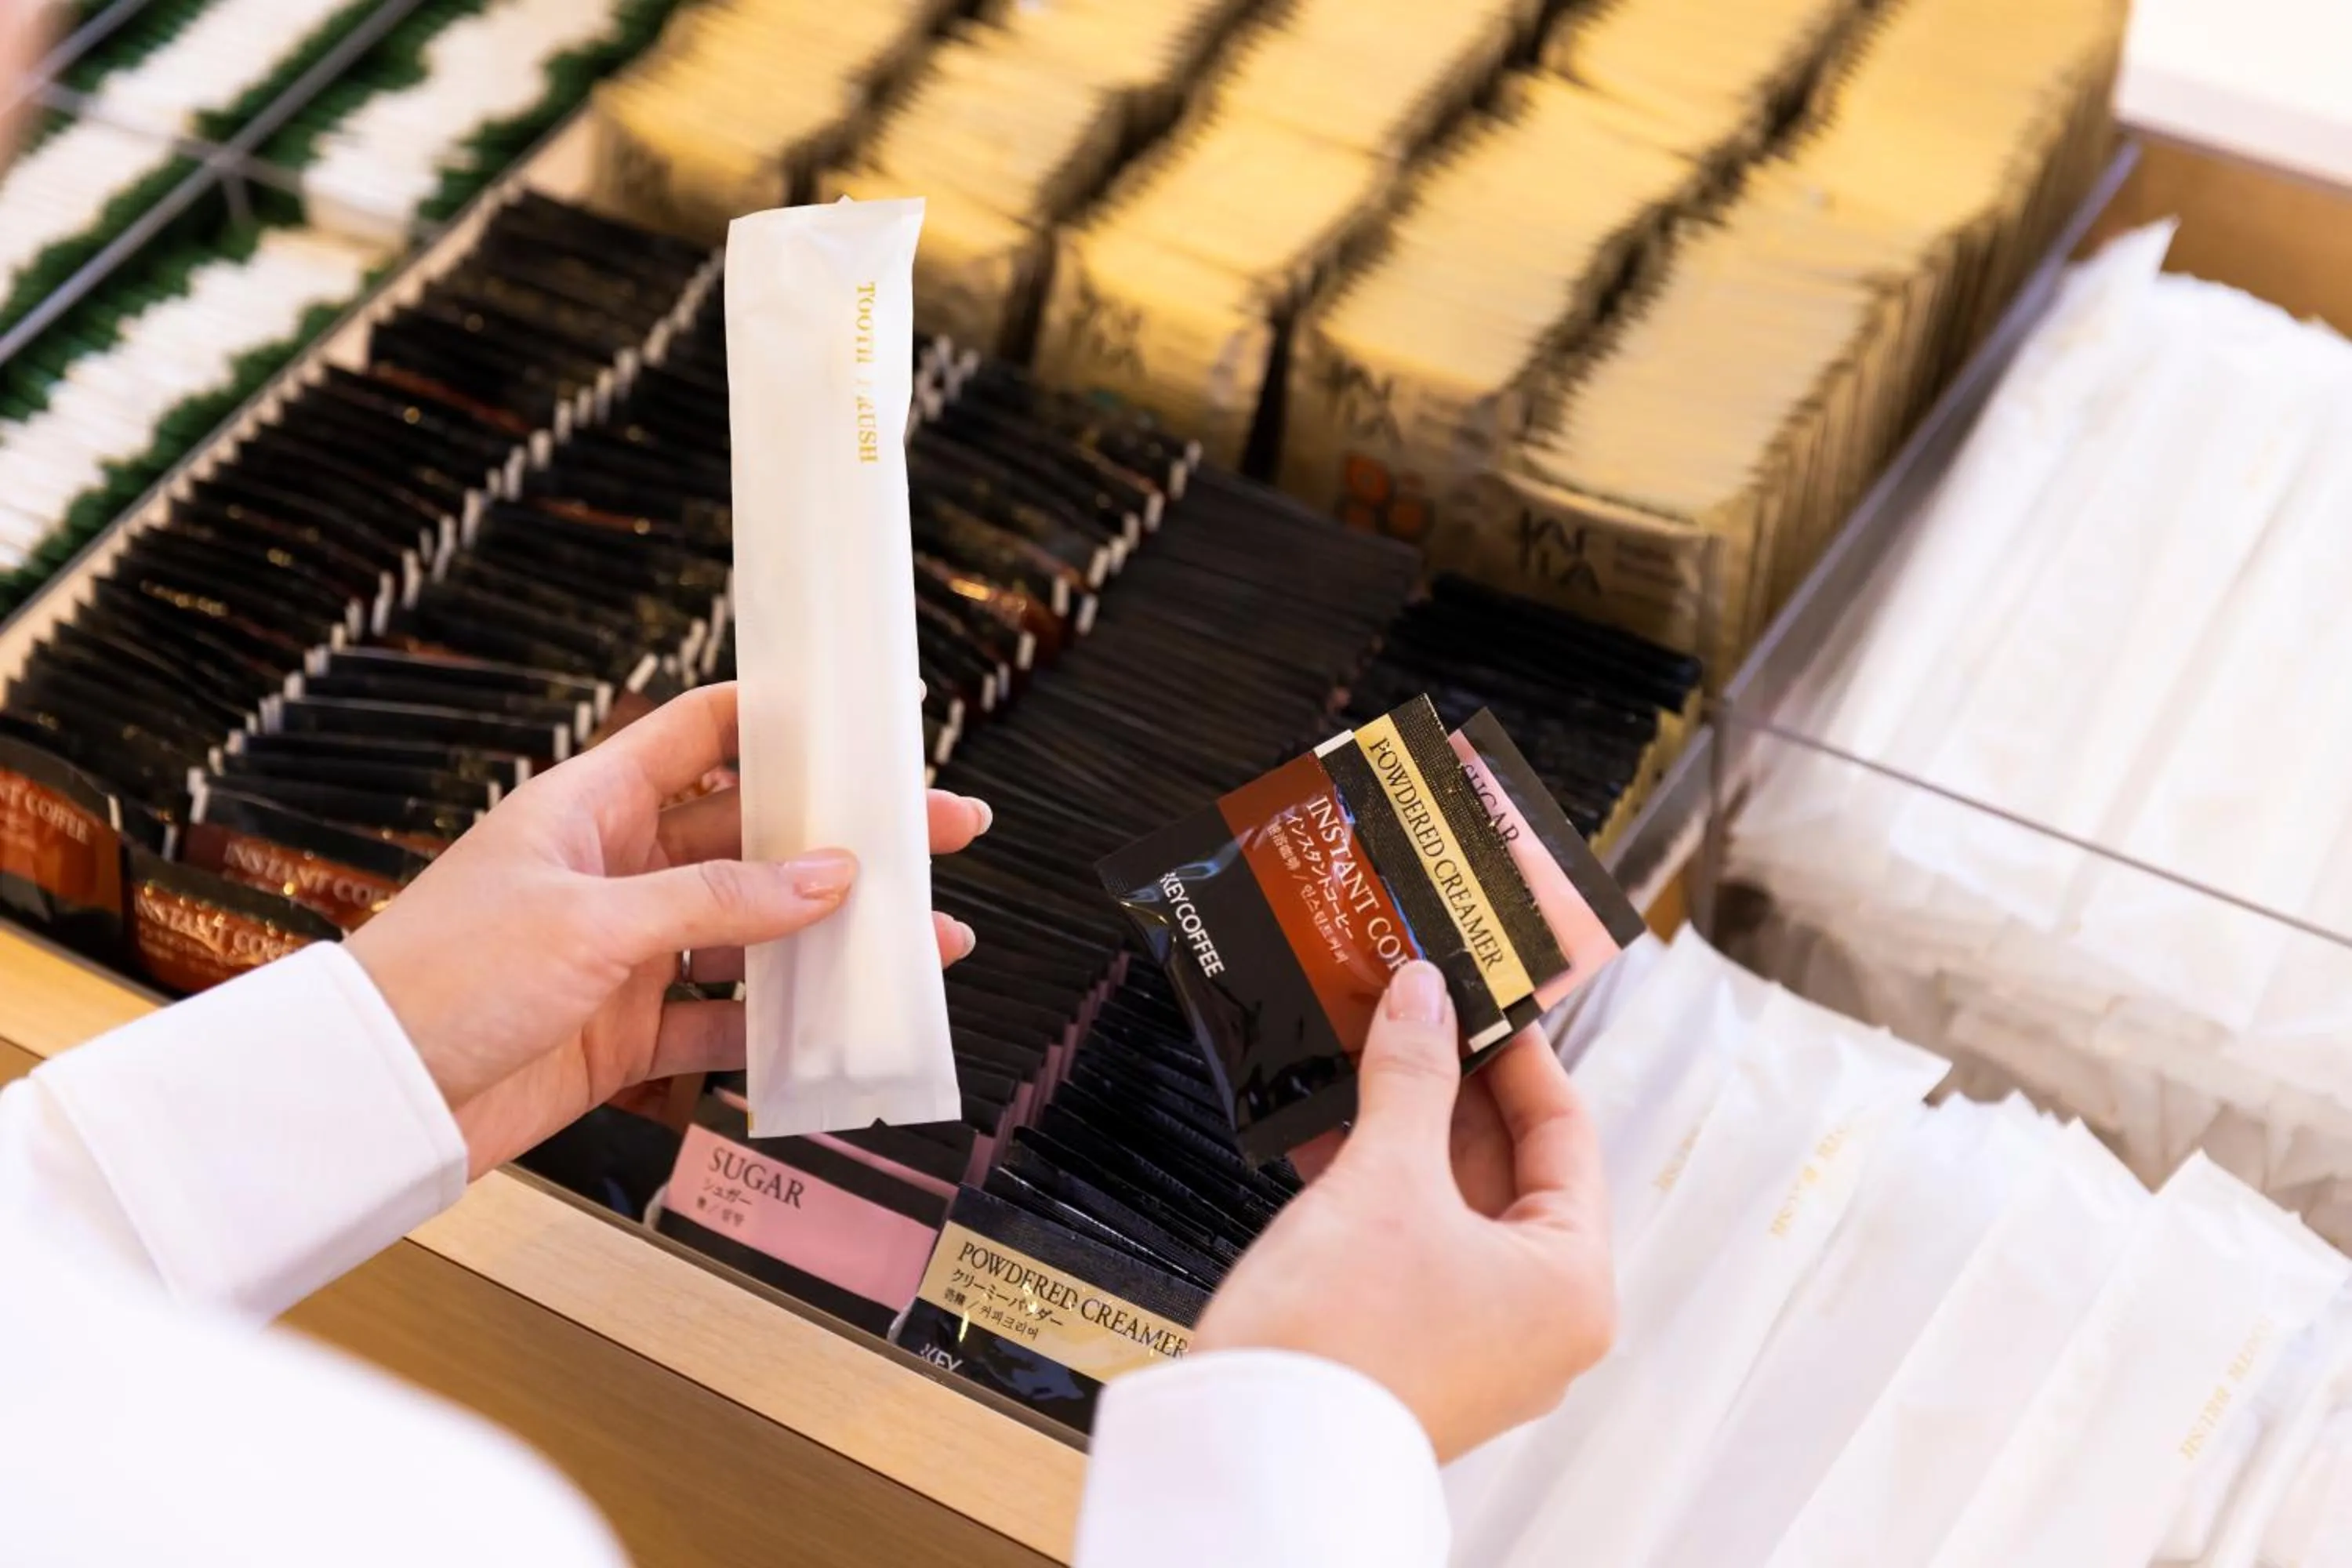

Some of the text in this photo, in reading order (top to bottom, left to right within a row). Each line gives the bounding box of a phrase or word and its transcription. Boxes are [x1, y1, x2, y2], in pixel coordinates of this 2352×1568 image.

[855, 378, 878, 463] RUSH
[1285, 815, 1354, 939] インスタントコーヒー
[1305, 794, 1409, 972] INSTANT COF
[1369, 737, 1504, 972] POWDERED CREAMER
[708, 1145, 804, 1210] SUGAR
[920, 1341, 964, 1371] KEY
[957, 1241, 1188, 1359] POWDERED CREAMER
